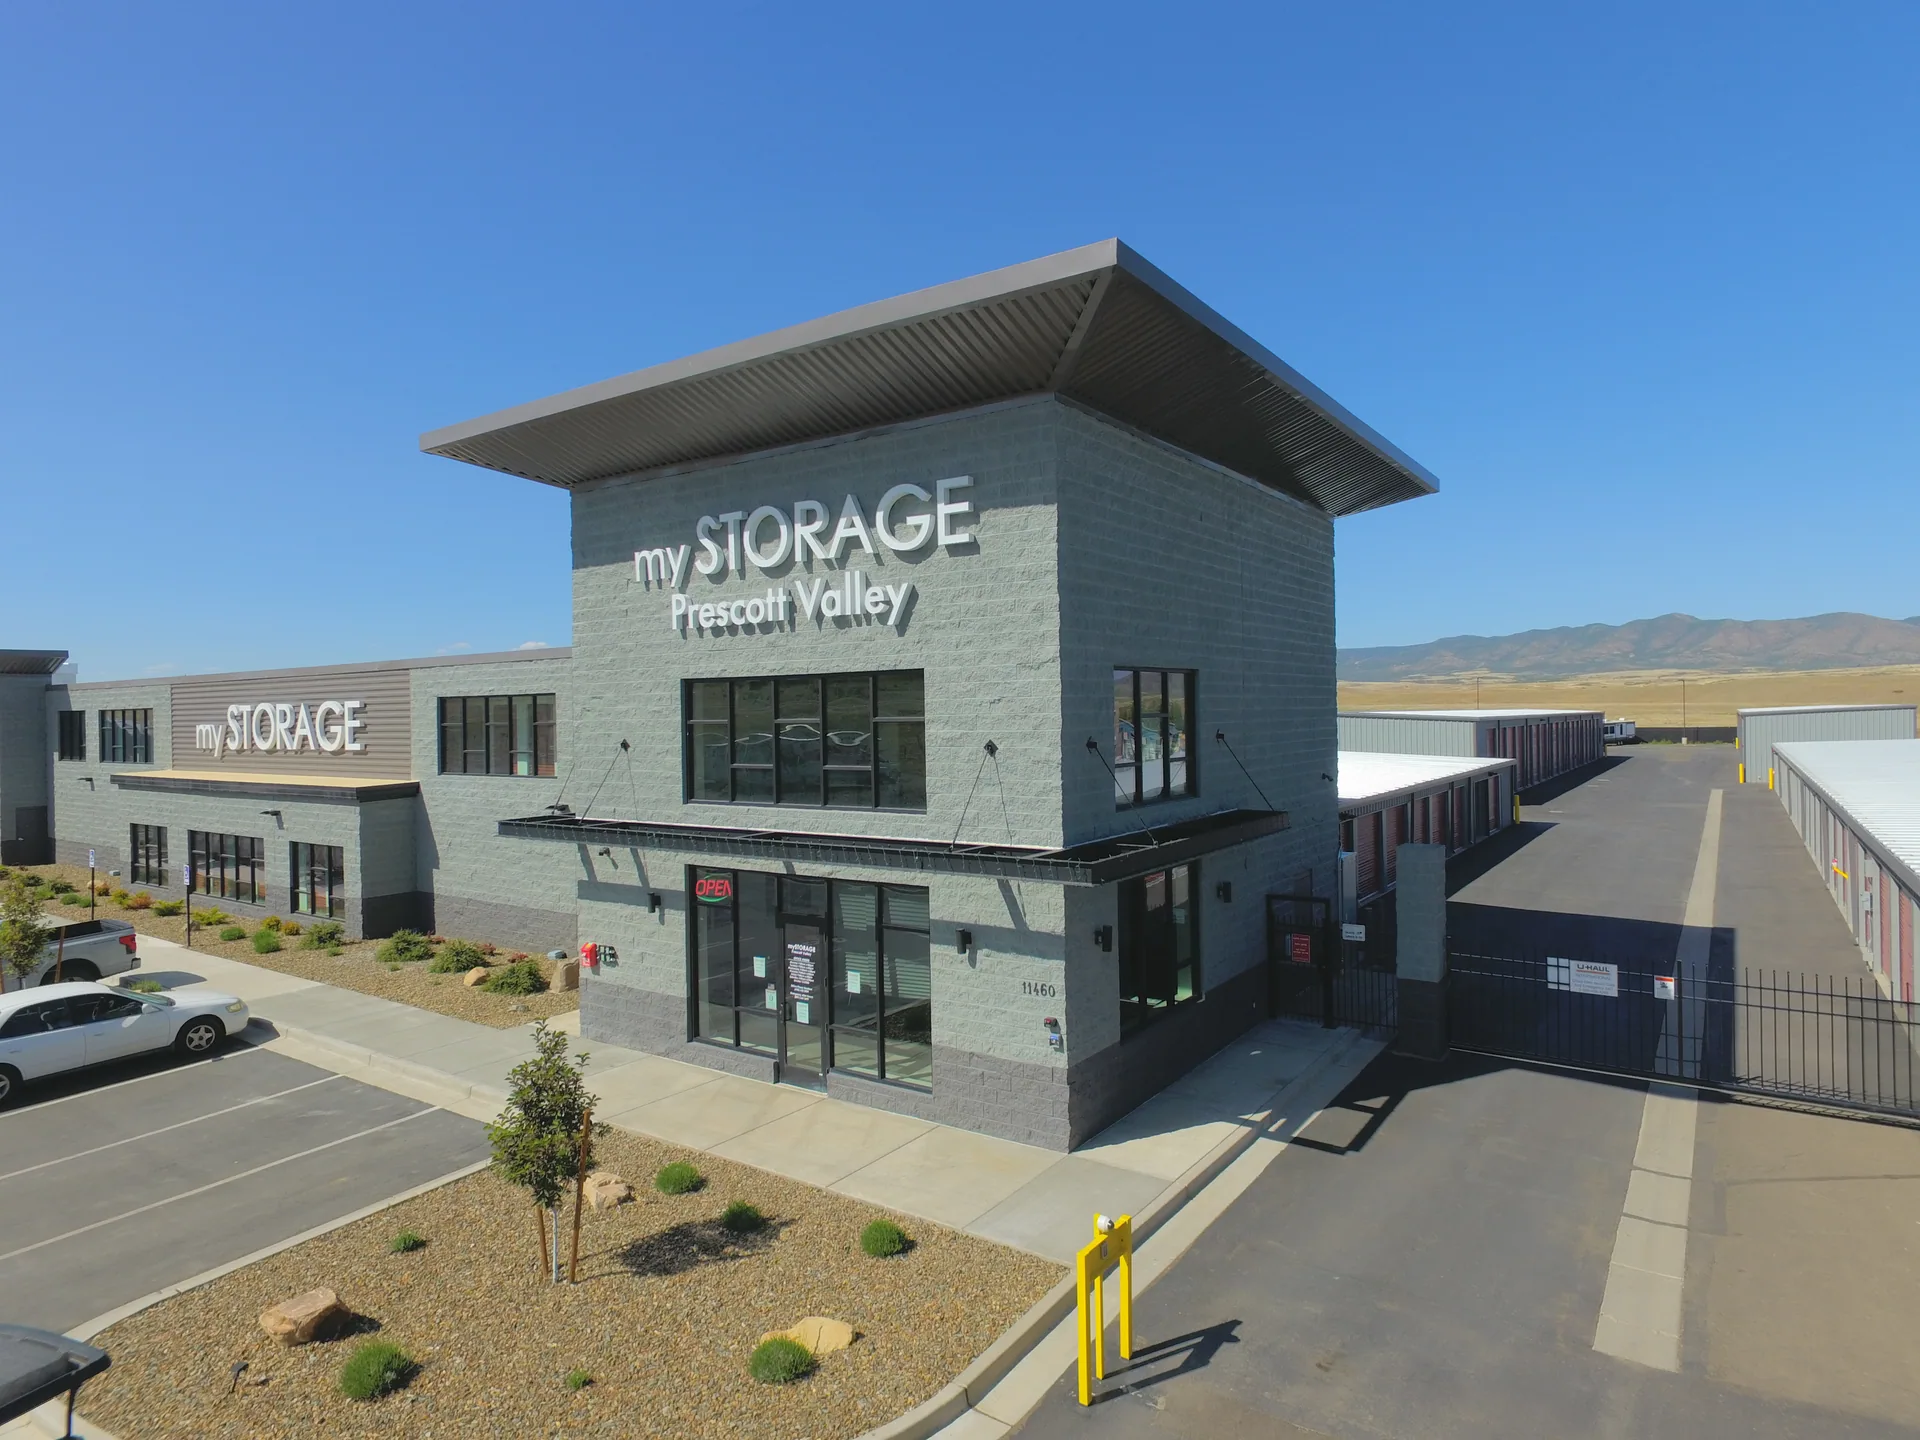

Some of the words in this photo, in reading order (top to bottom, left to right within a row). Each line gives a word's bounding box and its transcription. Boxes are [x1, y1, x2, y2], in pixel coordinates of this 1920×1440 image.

[634, 544, 691, 588] my
[694, 475, 974, 575] STORAGE
[671, 587, 791, 630] Prescott
[795, 570, 912, 626] Valley
[196, 723, 226, 757] my
[227, 701, 363, 751] STORAGE
[695, 879, 732, 896] OPEN
[1576, 964, 1610, 973] U-HAUL
[1022, 981, 1056, 998] 11460
